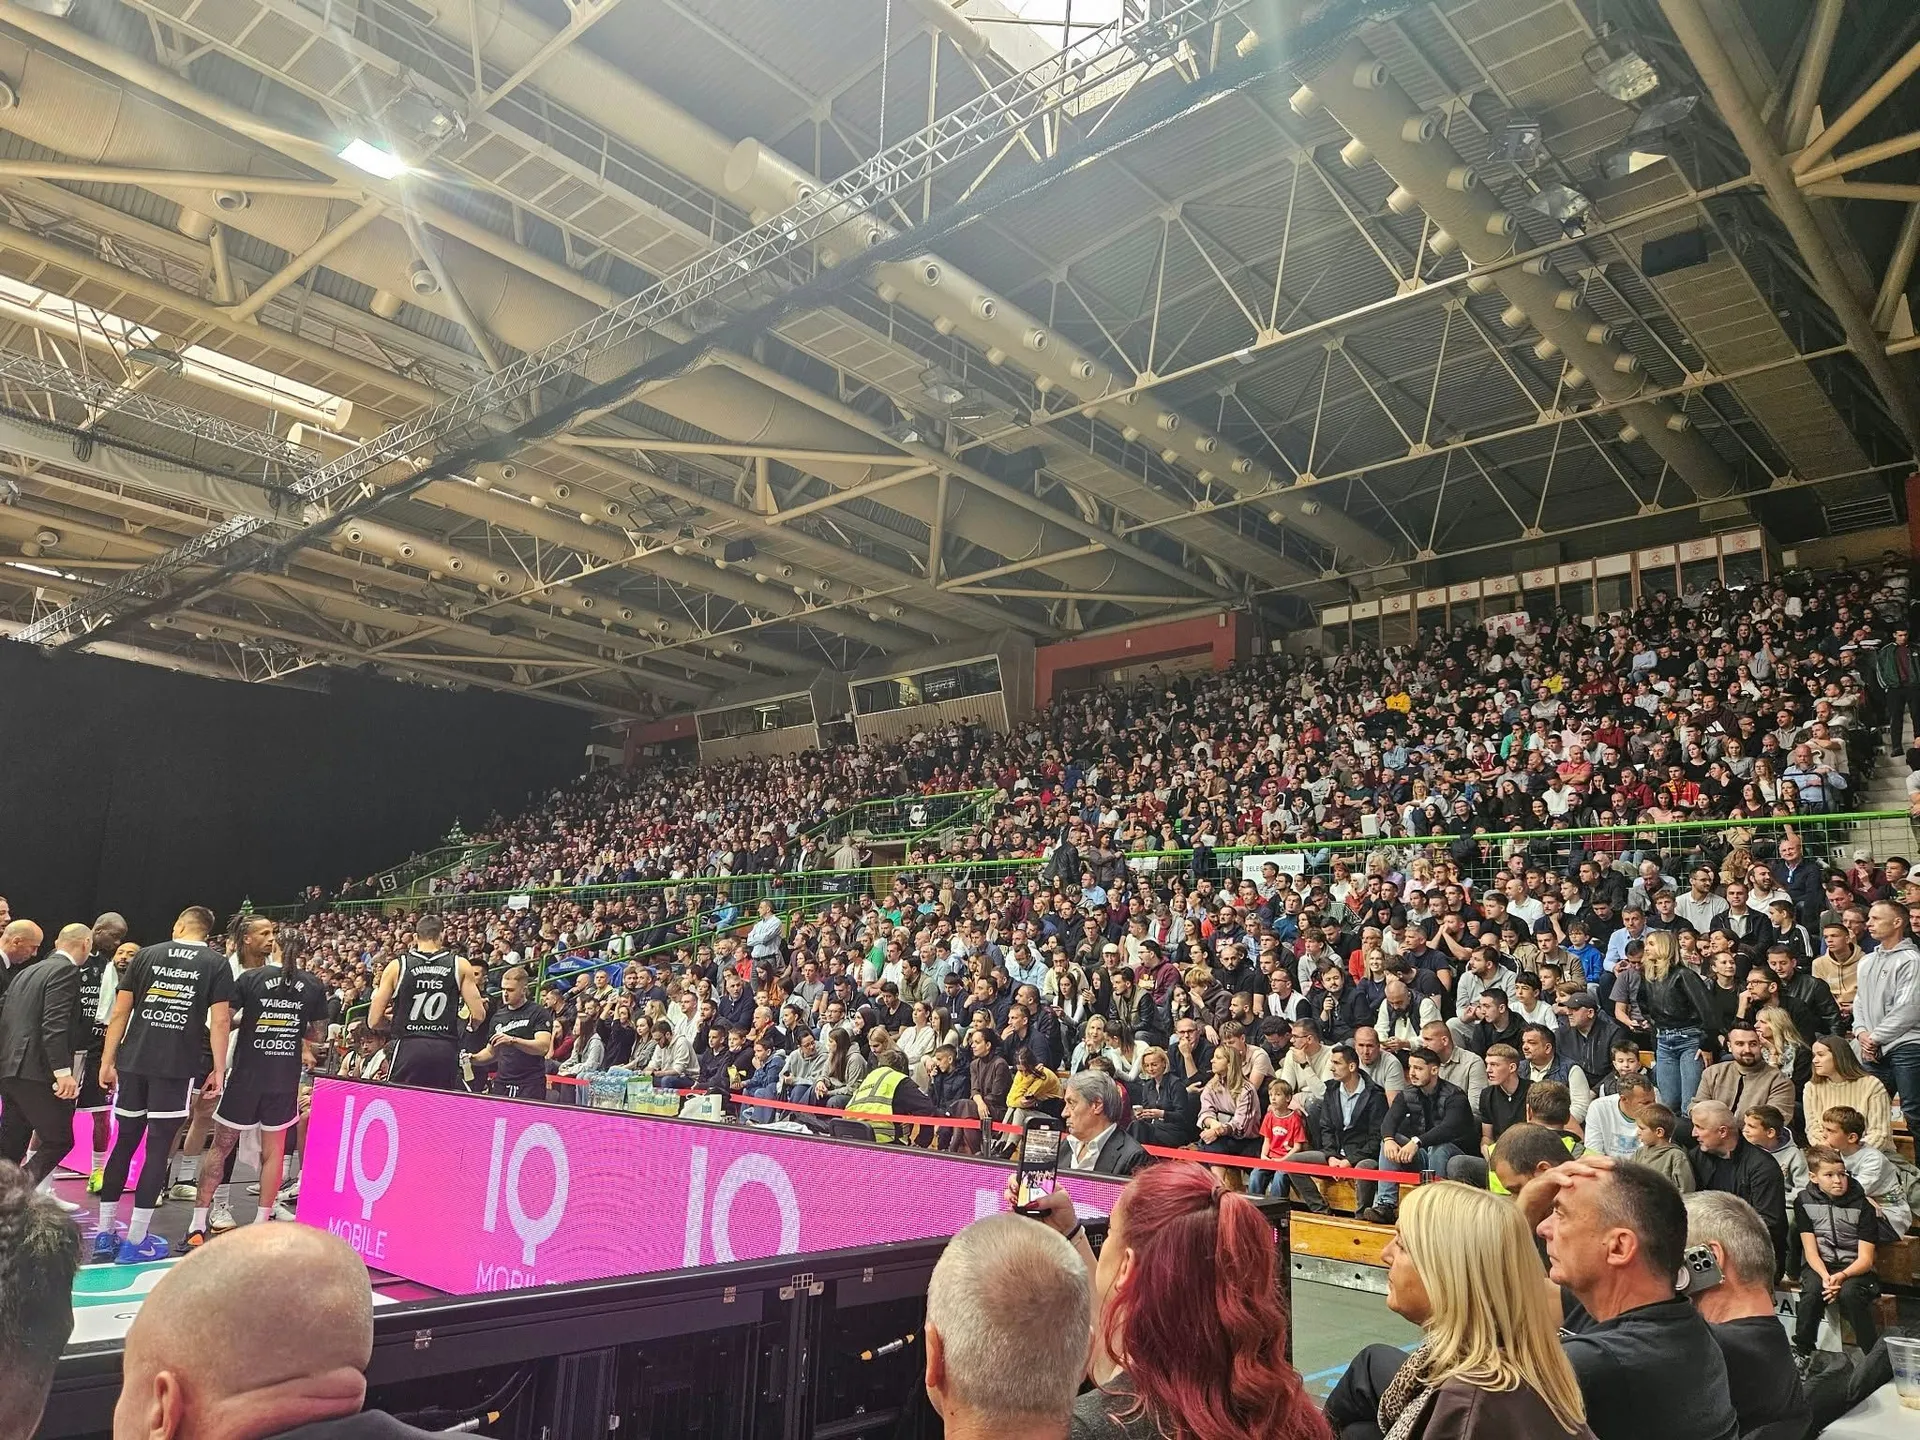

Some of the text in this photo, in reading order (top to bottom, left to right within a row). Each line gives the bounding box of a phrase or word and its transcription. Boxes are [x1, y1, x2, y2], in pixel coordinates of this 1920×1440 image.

[158, 966, 200, 980] AikBank
[151, 980, 196, 994] ADMIRAL
[416, 979, 443, 989] mts
[266, 999, 304, 1010] AikBank
[409, 991, 448, 1021] 10
[141, 1009, 188, 1024] GLOBOS
[260, 1011, 300, 1021] ADMIRAL
[253, 1039, 296, 1050] GLOBOS
[334, 1094, 398, 1221] IQ
[483, 1117, 570, 1267] IQ
[329, 1216, 388, 1260] MOBILE
